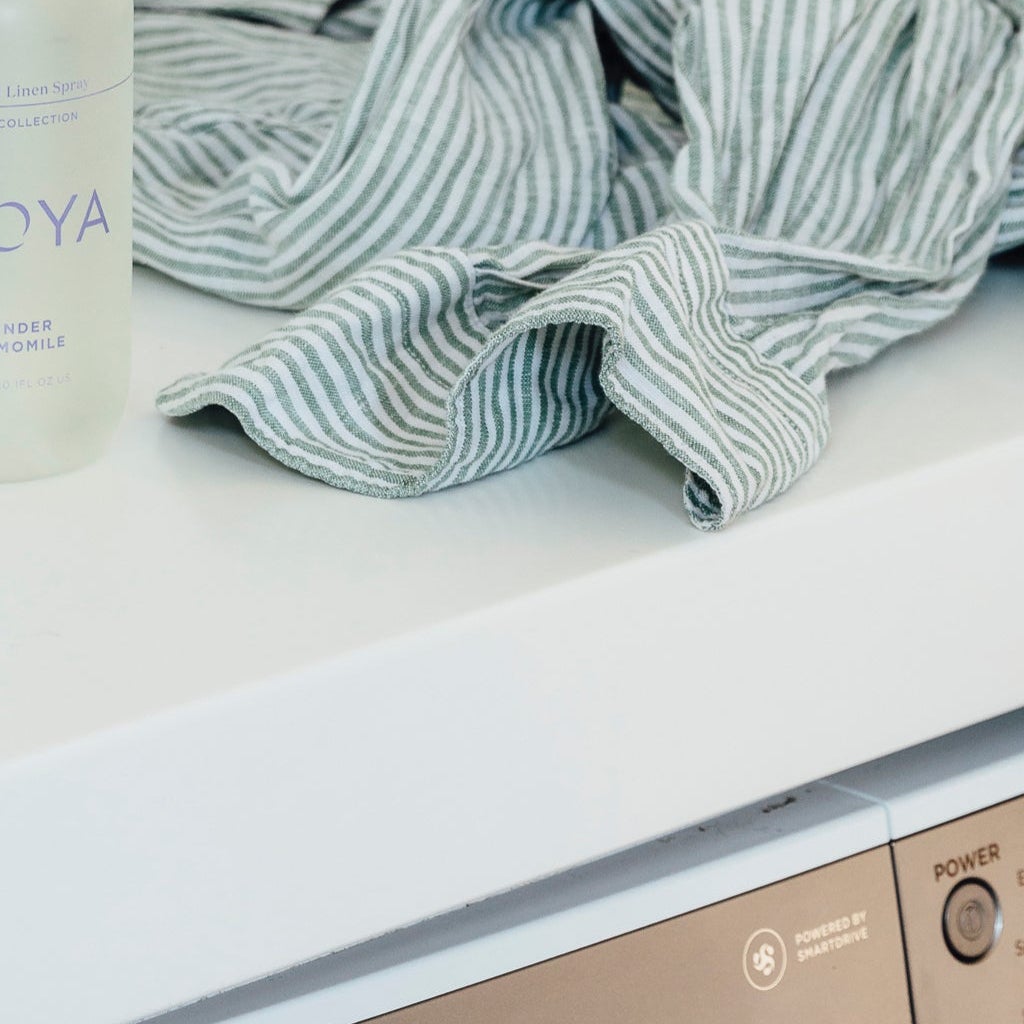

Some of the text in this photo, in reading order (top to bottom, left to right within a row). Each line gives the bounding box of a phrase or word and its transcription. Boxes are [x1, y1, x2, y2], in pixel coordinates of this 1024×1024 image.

[7, 83, 48, 98] Linen
[52, 78, 89, 96] Spray
[934, 843, 1000, 881] POWER
[795, 909, 868, 947] POWERED BY
[797, 927, 869, 963] SMARTDRIVE
